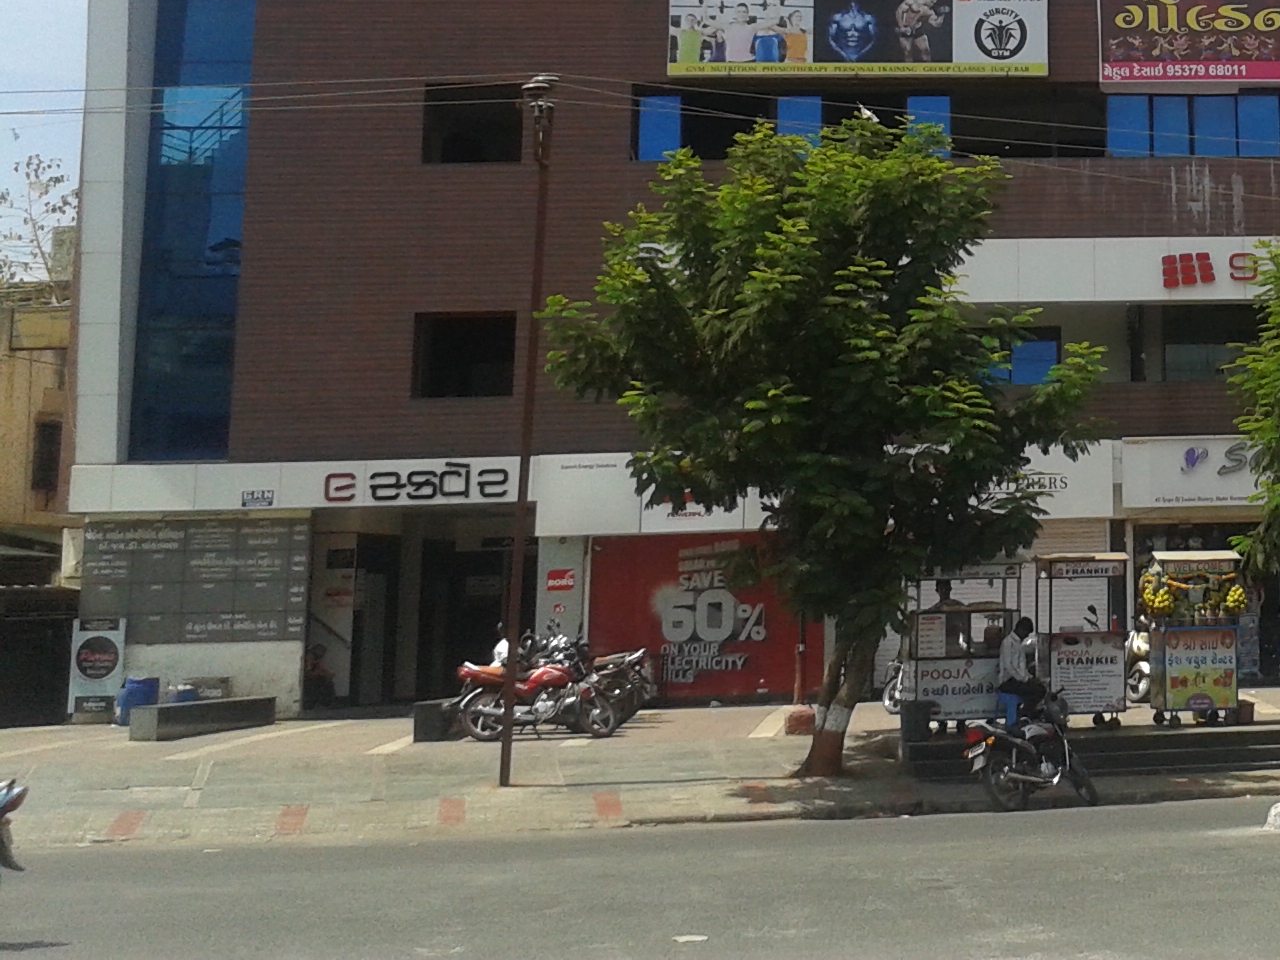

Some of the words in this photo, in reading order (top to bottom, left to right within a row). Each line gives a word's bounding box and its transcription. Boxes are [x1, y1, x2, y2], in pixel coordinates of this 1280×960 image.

[1166, 64, 1205, 76] 95379
[1209, 64, 1247, 76] 68011
[1065, 567, 1110, 575] FRANKIE
[679, 570, 726, 591] SAVE
[683, 644, 719, 657] YOUR
[1057, 656, 1117, 666] FRANKIE
[921, 668, 971, 681] POOJA
